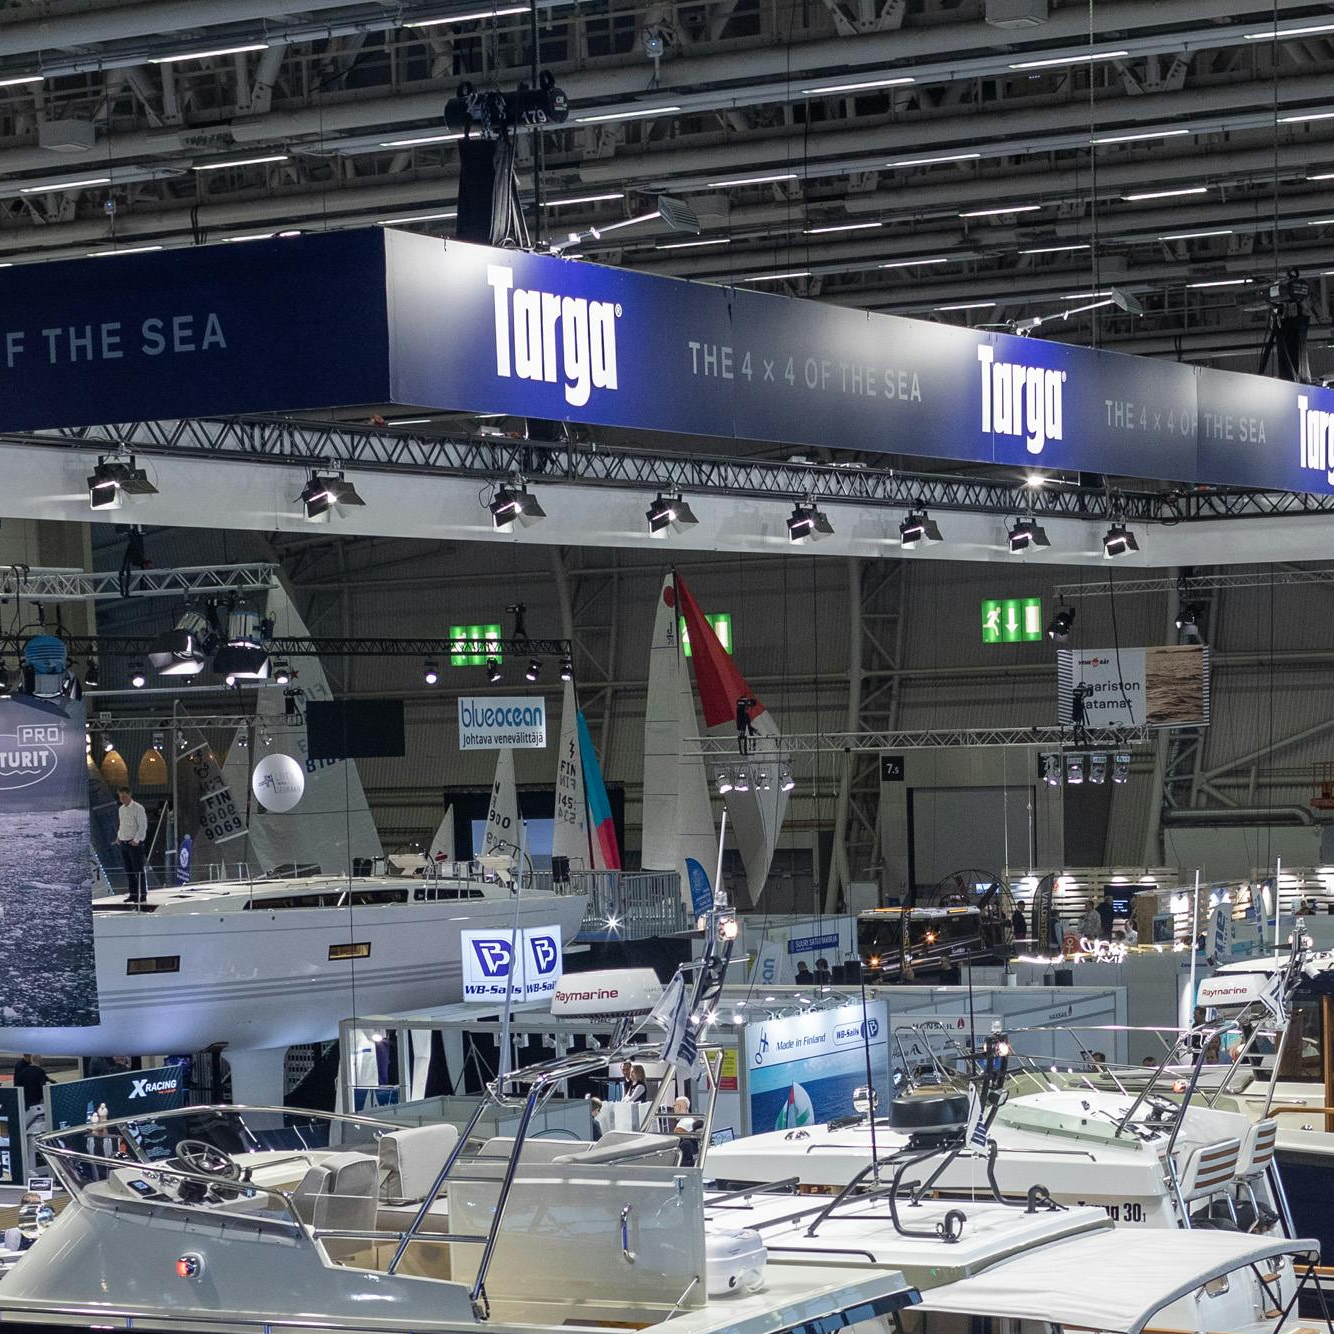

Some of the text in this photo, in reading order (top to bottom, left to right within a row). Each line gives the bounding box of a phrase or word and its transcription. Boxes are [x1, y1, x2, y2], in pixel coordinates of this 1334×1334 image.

[42, 322, 123, 363] THE
[142, 313, 227, 355] SEA
[487, 264, 618, 406] Targa
[688, 342, 733, 379] THE
[741, 351, 753, 381] 4
[783, 356, 796, 386] 4
[804, 358, 830, 390] OF
[840, 362, 877, 397] THE
[885, 367, 922, 402] SEA
[978, 344, 1062, 454] Targa
[1105, 400, 1134, 429] THE
[1139, 406, 1147, 431] 4
[1166, 412, 1175, 434] 4
[1180, 414, 1198, 438] OF
[1204, 415, 1234, 440] THE
[1239, 417, 1266, 443] SEA
[461, 700, 543, 728] blueocean
[1081, 698, 1132, 710] atamat
[23, 727, 59, 743] PRO
[205, 816, 243, 841] 9069
[466, 985, 522, 995] WB-Sals
[555, 989, 619, 1004] Raymarine
[1202, 987, 1248, 998] Raymarine
[776, 1039, 794, 1051] Made
[803, 1032, 826, 1046] Finland
